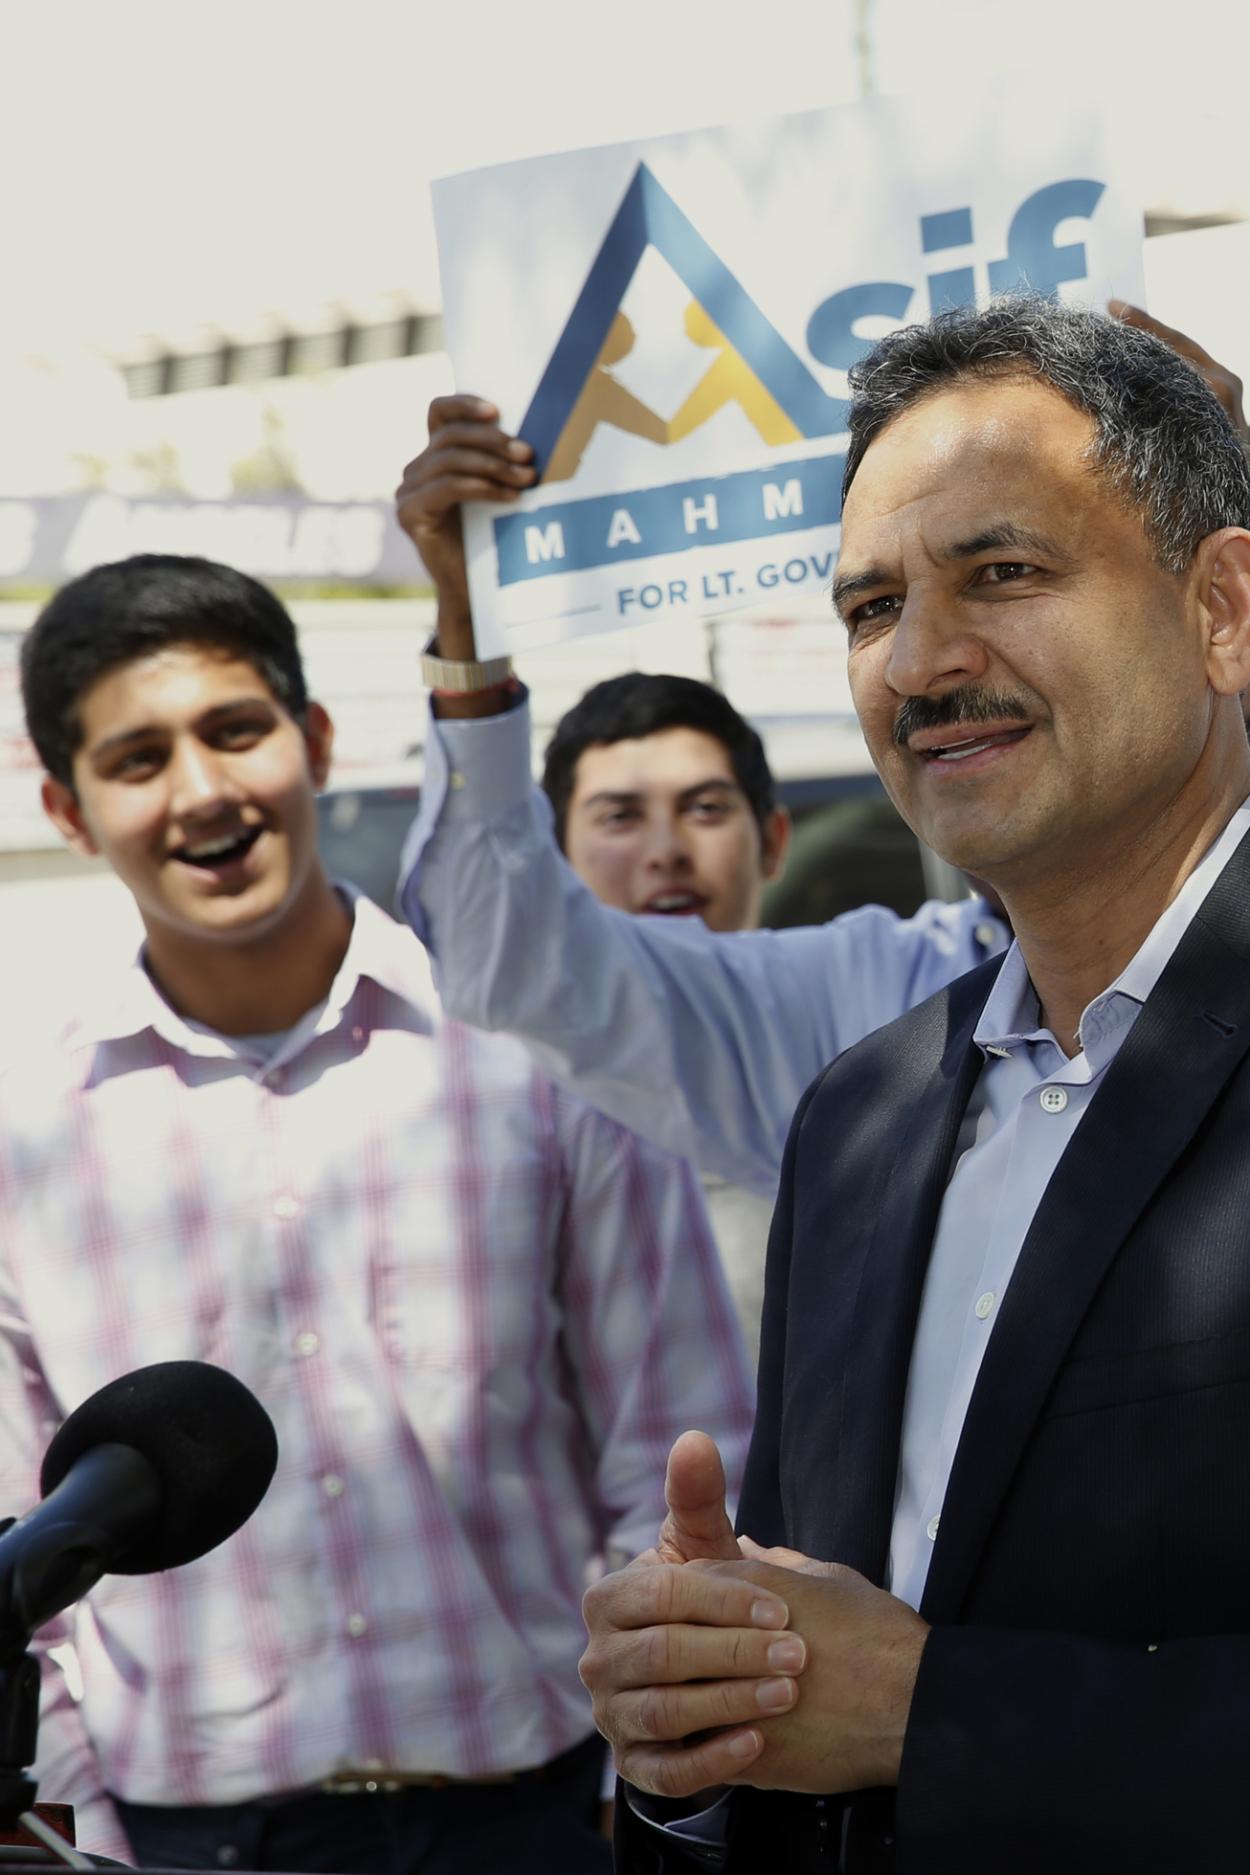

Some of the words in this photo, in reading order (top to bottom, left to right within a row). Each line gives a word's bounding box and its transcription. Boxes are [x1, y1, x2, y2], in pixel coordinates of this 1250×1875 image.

[617, 579, 688, 615] FOR
[702, 570, 743, 600] LT.
[757, 551, 838, 588] GOV
